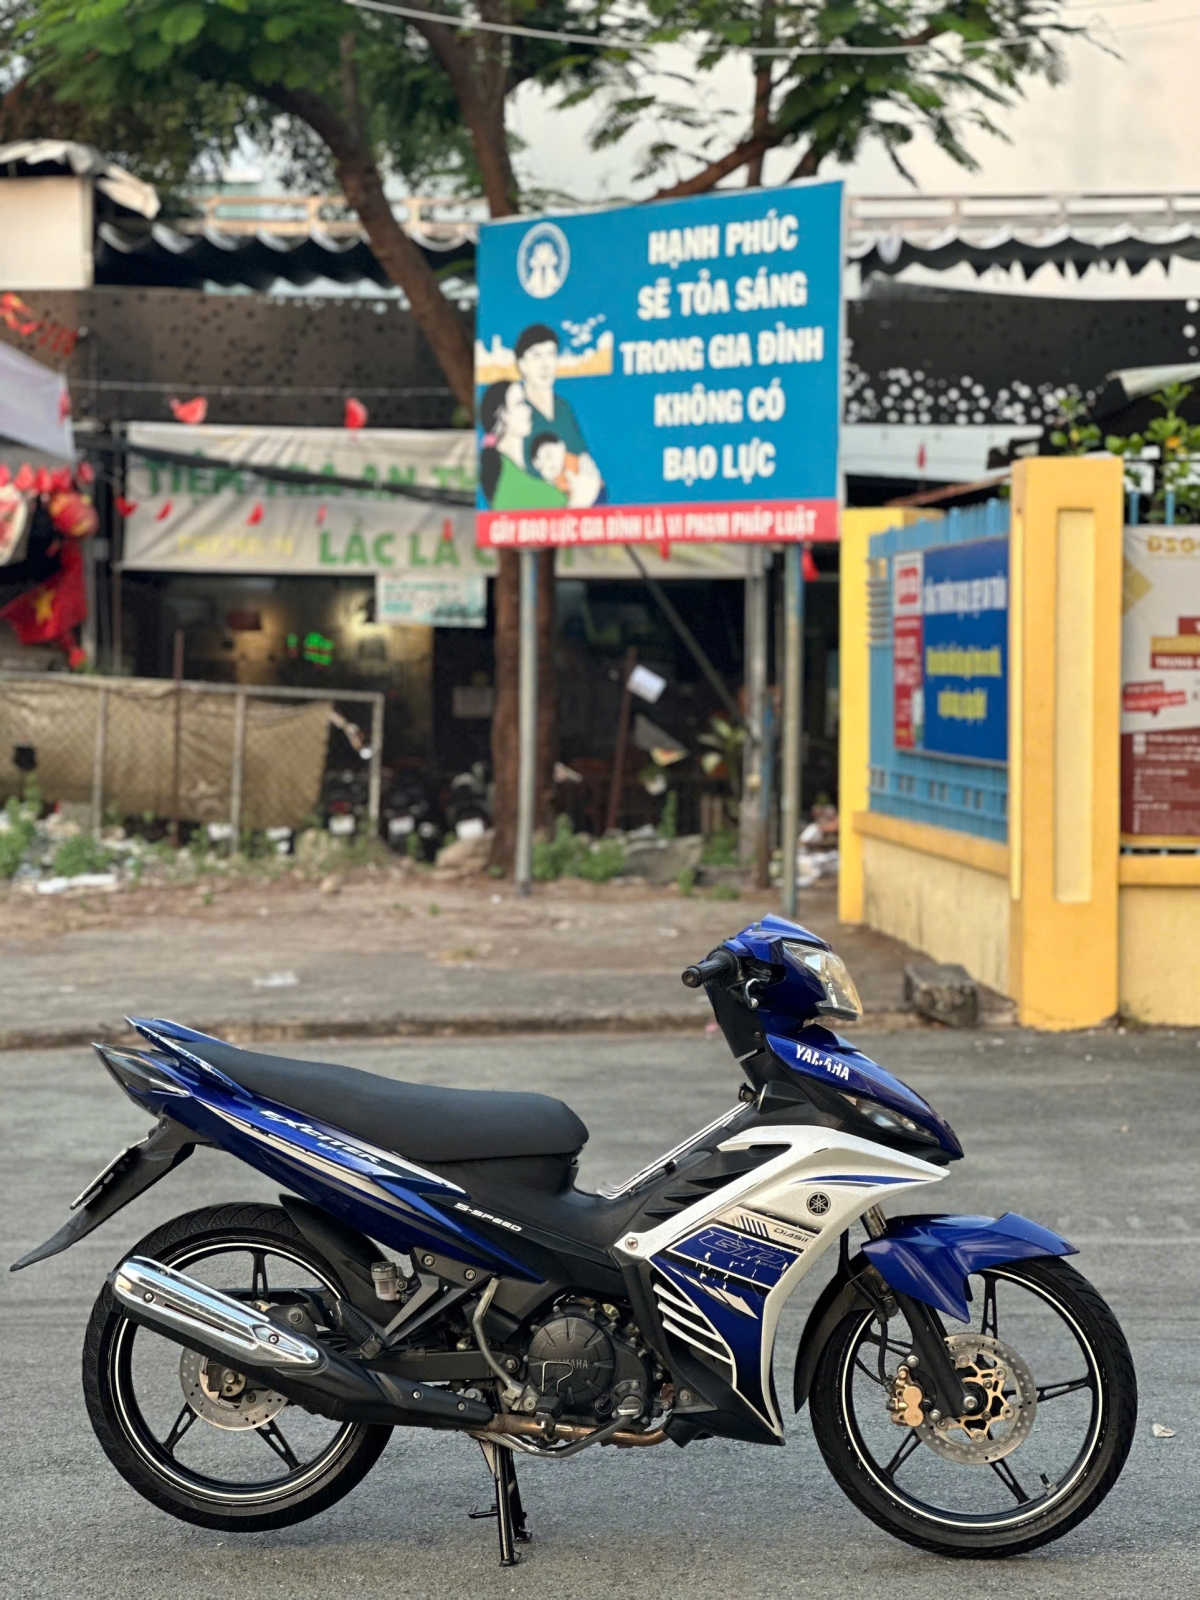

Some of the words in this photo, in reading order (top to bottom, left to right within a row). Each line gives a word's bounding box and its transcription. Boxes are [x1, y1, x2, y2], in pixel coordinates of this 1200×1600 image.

[648, 224, 720, 269] HẠNH
[725, 208, 799, 257] PHÚC
[637, 277, 672, 320] SẼ
[677, 268, 731, 317] TỎA
[734, 266, 808, 312] SÁNG
[619, 336, 704, 375] TRONG
[708, 333, 752, 369] GIA
[757, 321, 824, 365] ĐÌNH
[654, 382, 743, 427] KHÔNG
[747, 377, 786, 422] CÓ
[663, 444, 718, 487] BẠO
[722, 437, 776, 485] LỰC
[644, 509, 664, 540] LÀ
[731, 506, 773, 537] PHÁP
[775, 505, 817, 539] LUẬT
[796, 1044, 850, 1080] YAMAHA
